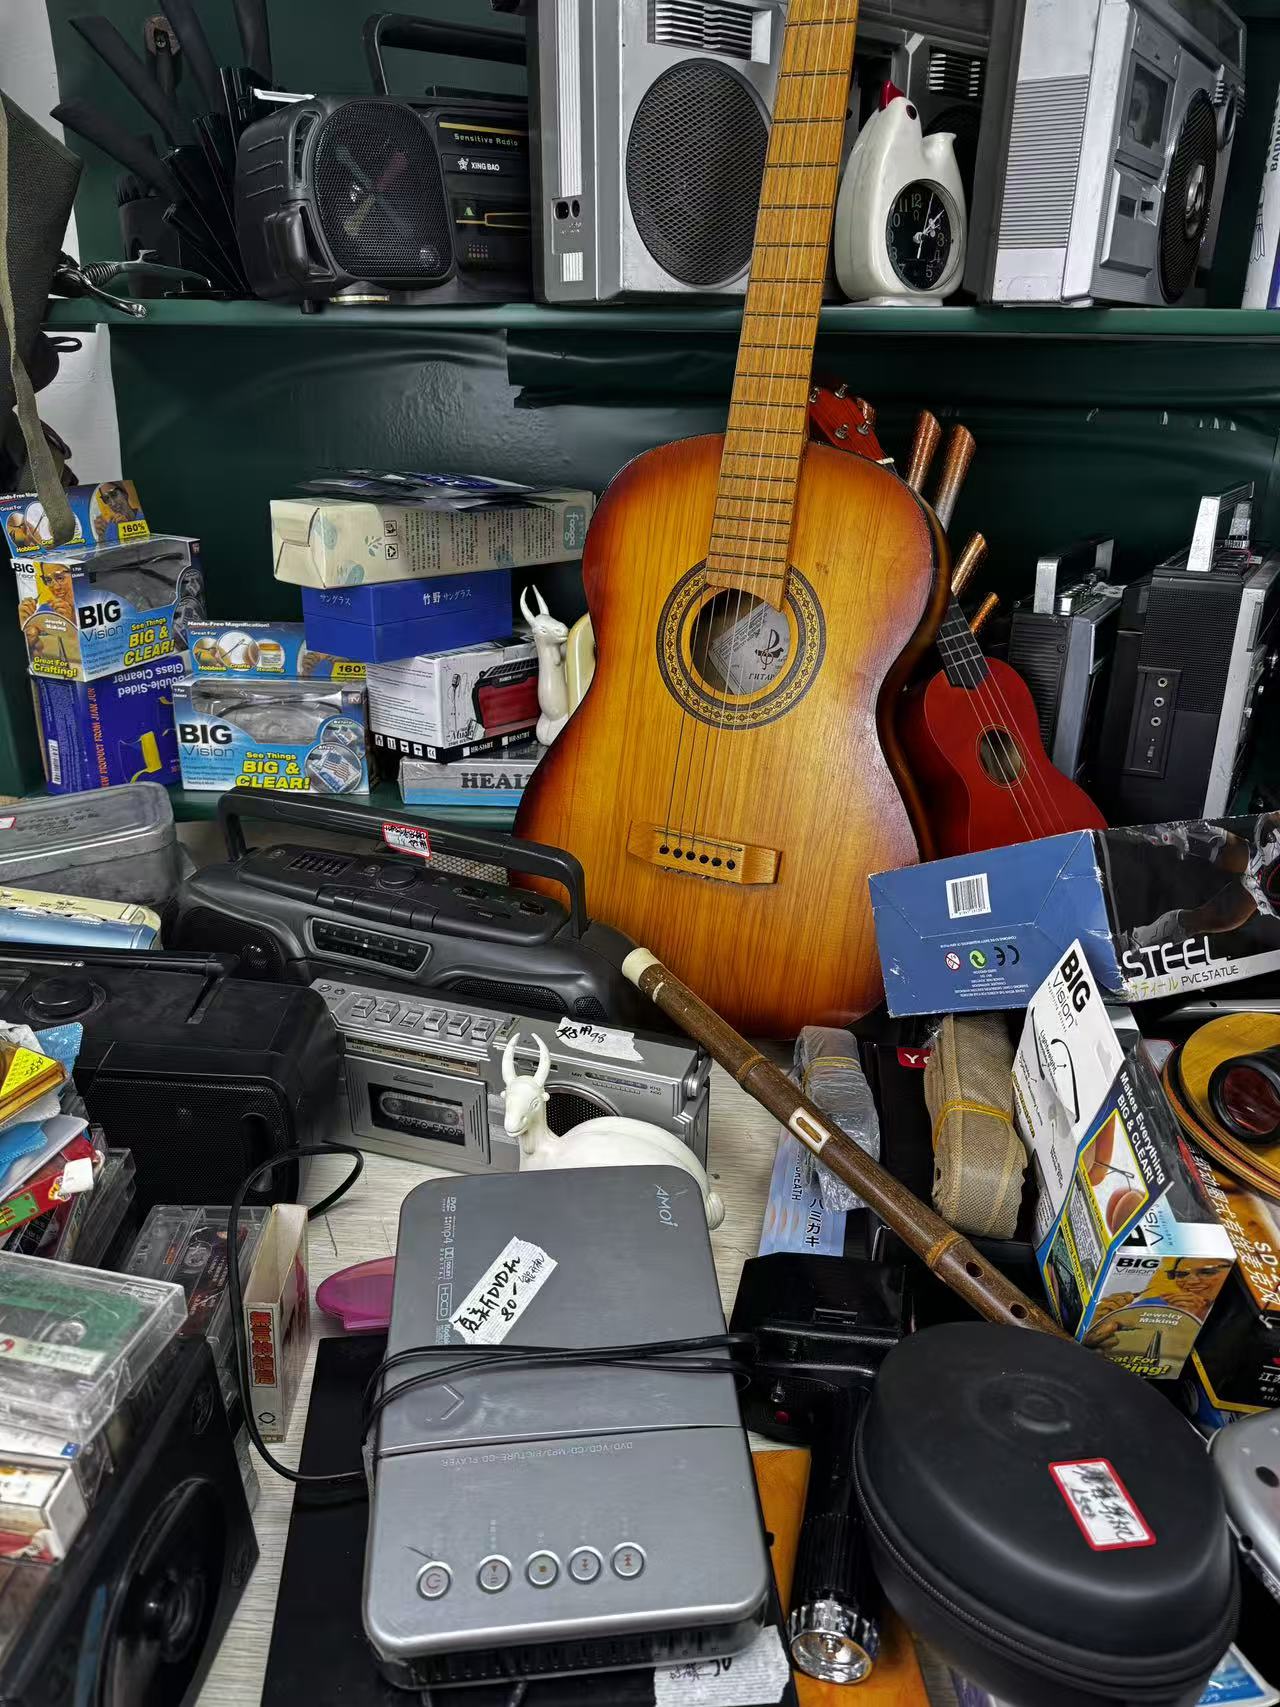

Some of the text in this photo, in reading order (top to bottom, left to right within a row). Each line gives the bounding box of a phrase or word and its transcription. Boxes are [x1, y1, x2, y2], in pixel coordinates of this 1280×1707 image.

[453, 133, 518, 147] Sensitive Radio
[471, 161, 500, 171] XING BAO
[911, 193, 922, 209] 12
[936, 232, 945, 248] 3
[926, 264, 934, 278] 5
[121, 520, 146, 533] 160%
[16, 545, 40, 553] Hobbies
[13, 563, 35, 574] BIG
[319, 592, 352, 606] サングラス
[422, 588, 473, 606] 竹野 サングラス
[77, 600, 121, 630] BIG
[131, 617, 168, 632] See Things
[187, 620, 270, 629] Hands-Free Magnification!
[81, 624, 124, 643] Vision
[128, 631, 156, 649] BIG
[157, 625, 169, 639] &
[123, 639, 176, 667] CLEAR!
[33, 656, 54, 667] Great
[32, 663, 77, 678] Crafting!
[113, 663, 184, 684] Glass Cleaner
[87, 687, 97, 703] JUN
[89, 706, 100, 723] JIAN
[92, 723, 105, 742] FROM
[179, 724, 233, 745] BIG
[95, 742, 109, 774] PRODUCT
[181, 744, 235, 757] Vision
[245, 751, 297, 761] See Things
[242, 760, 300, 775] BIG &
[235, 776, 311, 790] CLEAR!
[1122, 935, 1228, 980] STEEL
[1060, 949, 1091, 1014] BIG
[1180, 974, 1202, 987] PVC
[1203, 964, 1239, 982] STATUE
[1053, 971, 1075, 1029] Vision
[432, 1122, 464, 1137] STOP
[1120, 1072, 1166, 1185] Makes Everything
[1116, 1094, 1156, 1186] BIG & CLEAR!
[805, 1197, 825, 1248] ハミガキ
[1145, 1208, 1164, 1247] Vis
[441, 1222, 453, 1245] mp4
[1116, 1257, 1160, 1268] BIG
[1115, 1267, 1156, 1275] Vision
[440, 1287, 449, 1317] HDCD
[1138, 1317, 1180, 1326] Making
[1139, 1311, 1183, 1320] Jewelry
[1131, 1355, 1158, 1365] For
[440, 1457, 479, 1467] PLAYER
